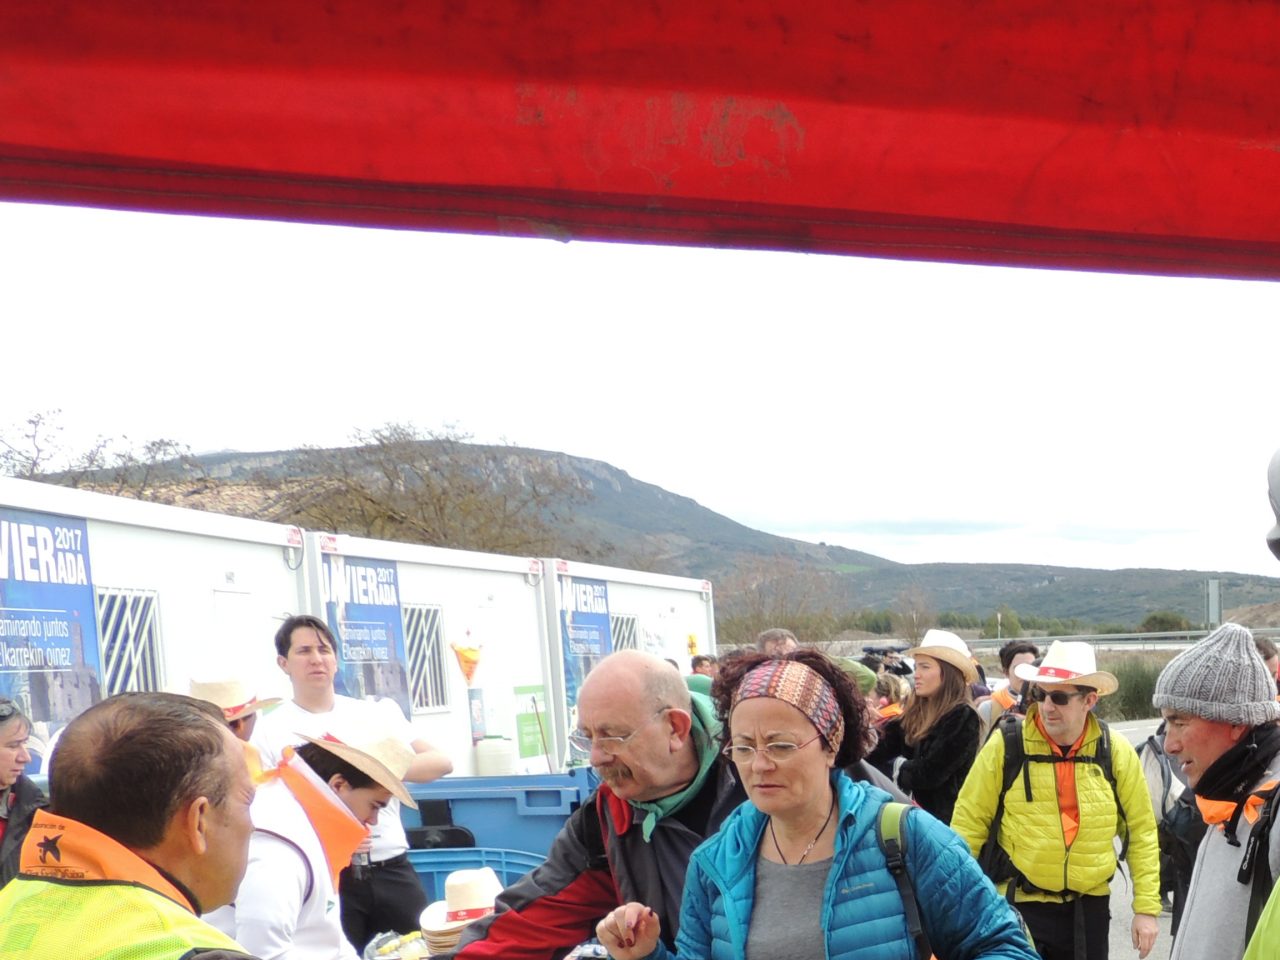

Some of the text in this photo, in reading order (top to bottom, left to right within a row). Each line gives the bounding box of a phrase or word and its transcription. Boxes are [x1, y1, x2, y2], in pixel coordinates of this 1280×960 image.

[55, 526, 82, 551] 2017
[57, 551, 88, 586] ADA
[376, 567, 394, 583] 2017
[378, 583, 398, 606] ADA
[43, 616, 70, 642] juntos
[46, 642, 72, 667] oinez
